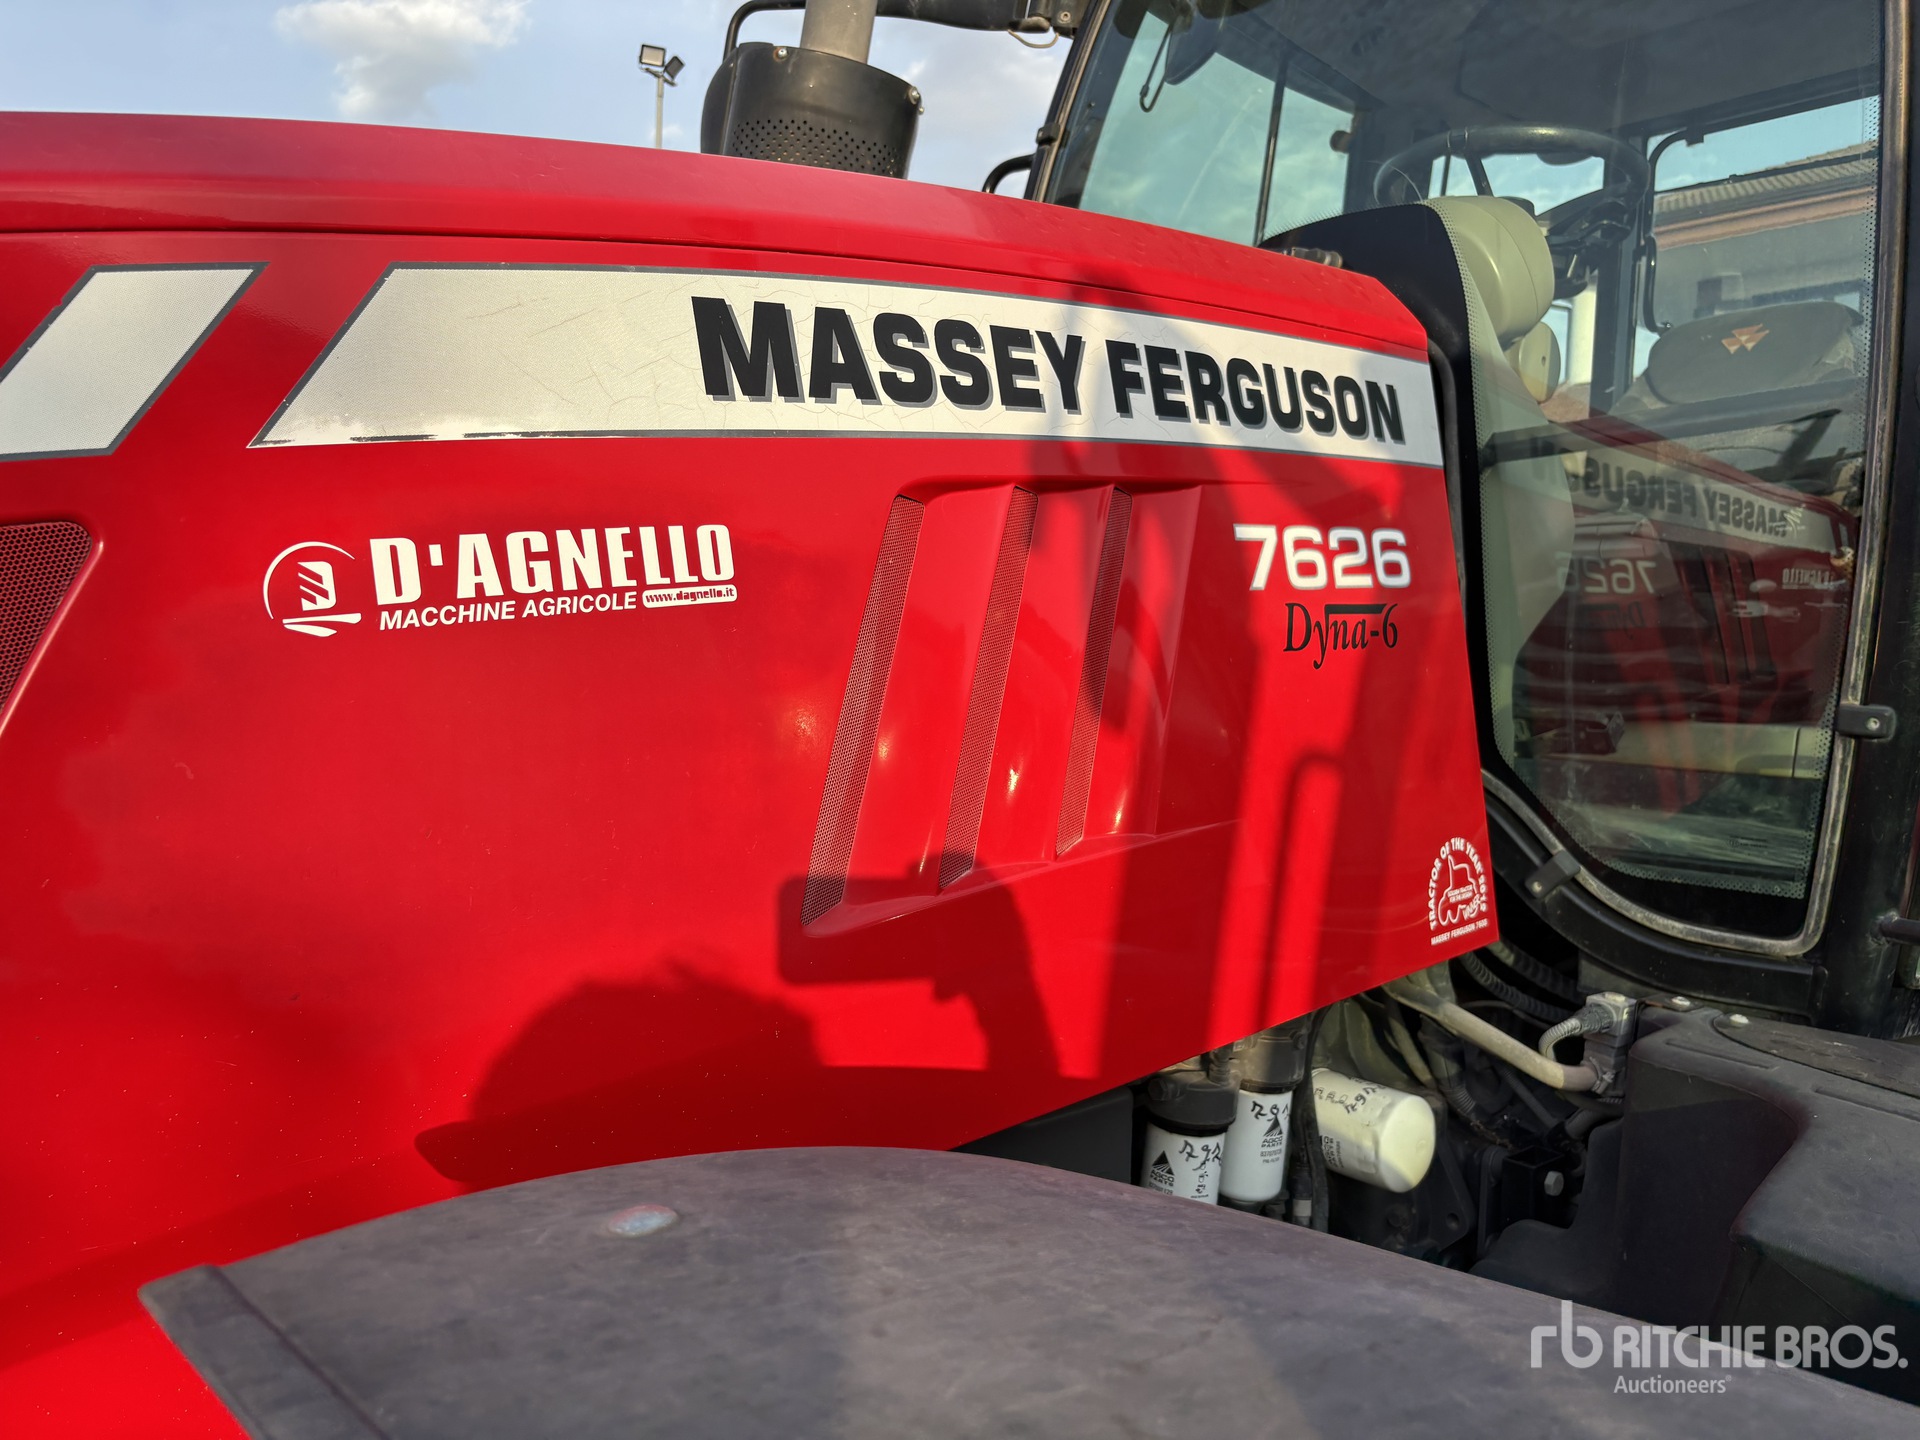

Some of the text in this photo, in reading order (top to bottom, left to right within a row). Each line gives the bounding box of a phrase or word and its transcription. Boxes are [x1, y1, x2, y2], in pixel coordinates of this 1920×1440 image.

[691, 296, 1406, 444] MASSEY FERGUSON
[369, 525, 734, 606] D'AGNELLO
[1233, 523, 1411, 591] 7626
[379, 587, 735, 631] MACCHINE AGRICOLE www.dagnello.it
[1283, 602, 1399, 670] Dyna-6
[1428, 857, 1442, 931] TRACTOR
[1440, 841, 1450, 860] OF
[1451, 837, 1465, 851] THE
